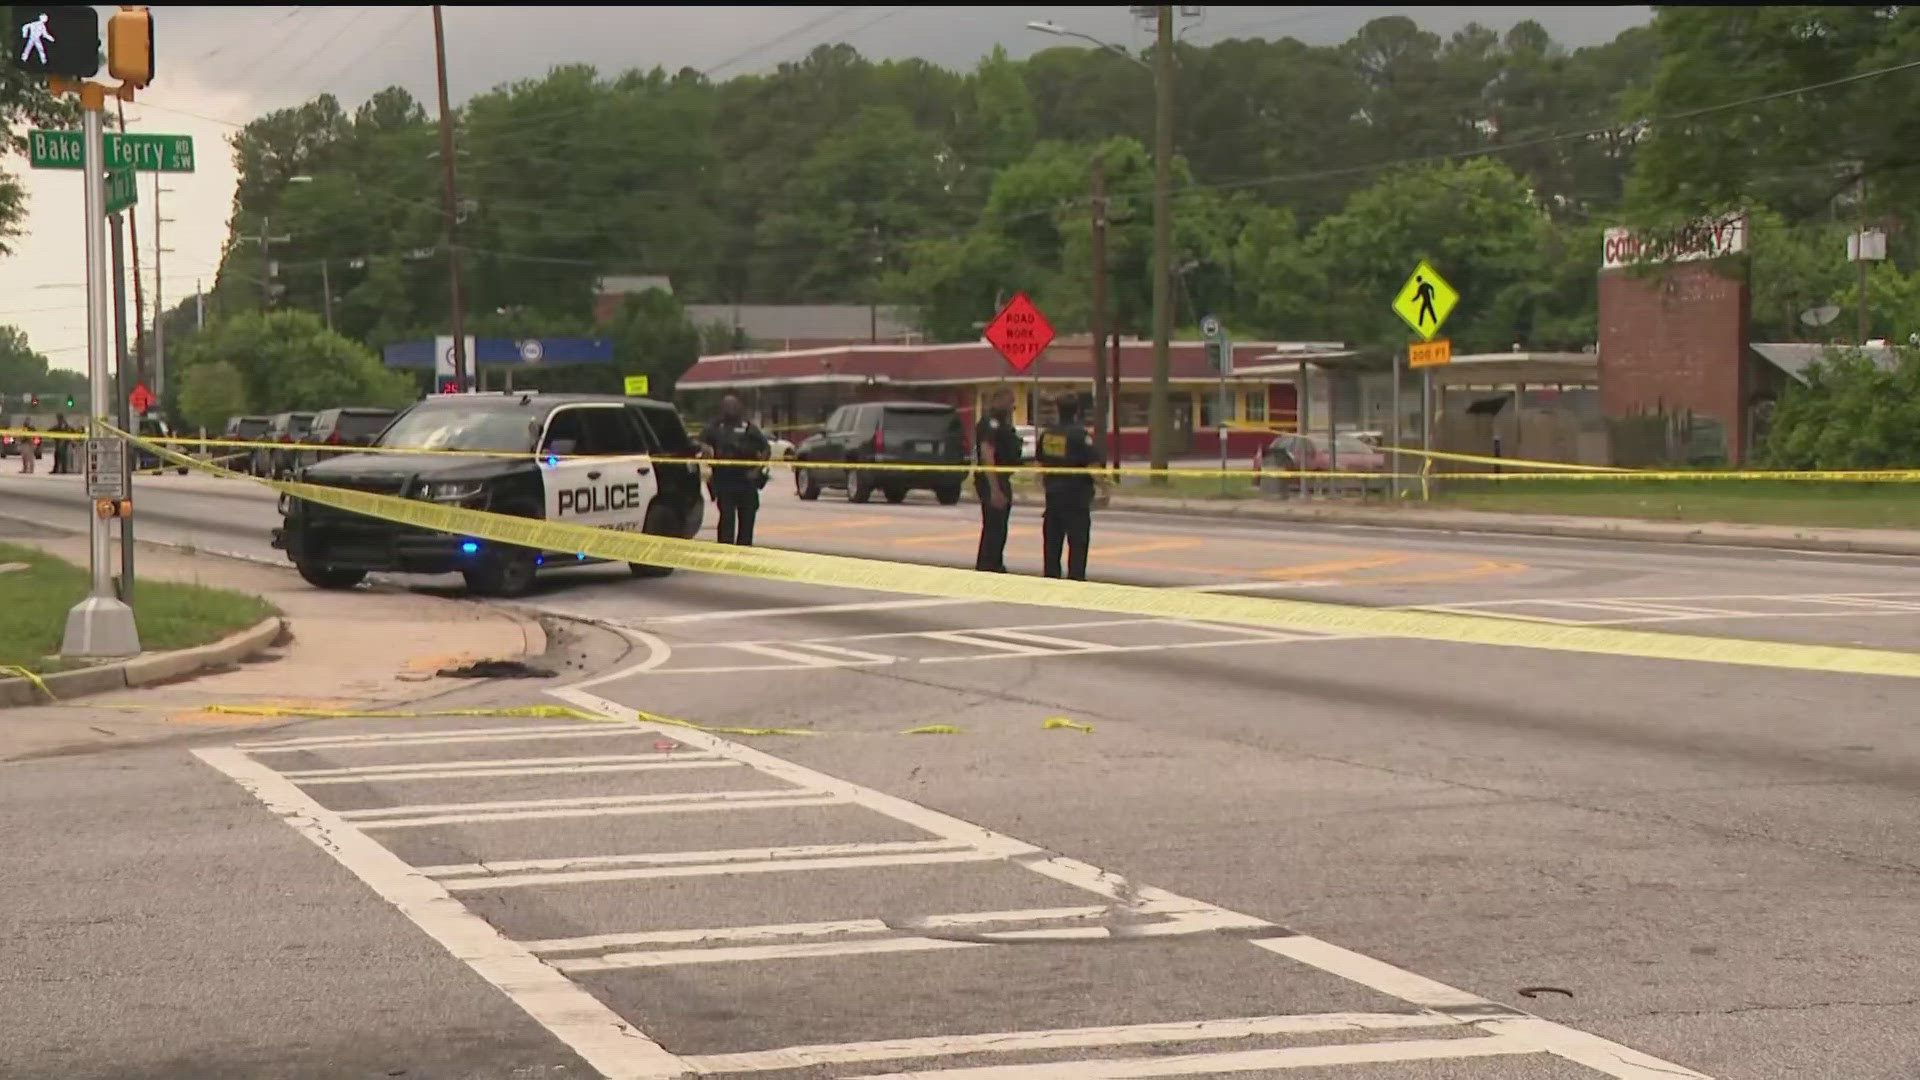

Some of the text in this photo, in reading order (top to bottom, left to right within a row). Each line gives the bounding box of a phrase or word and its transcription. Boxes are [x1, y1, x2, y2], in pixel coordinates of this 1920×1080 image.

[35, 133, 164, 170] Bake Ferry
[175, 140, 189, 154] RD
[172, 155, 192, 168] SW
[1006, 312, 1035, 324] ROAD
[1006, 328, 1034, 339] WORK
[1028, 343, 1039, 354] FT
[558, 482, 640, 516] POLICE
